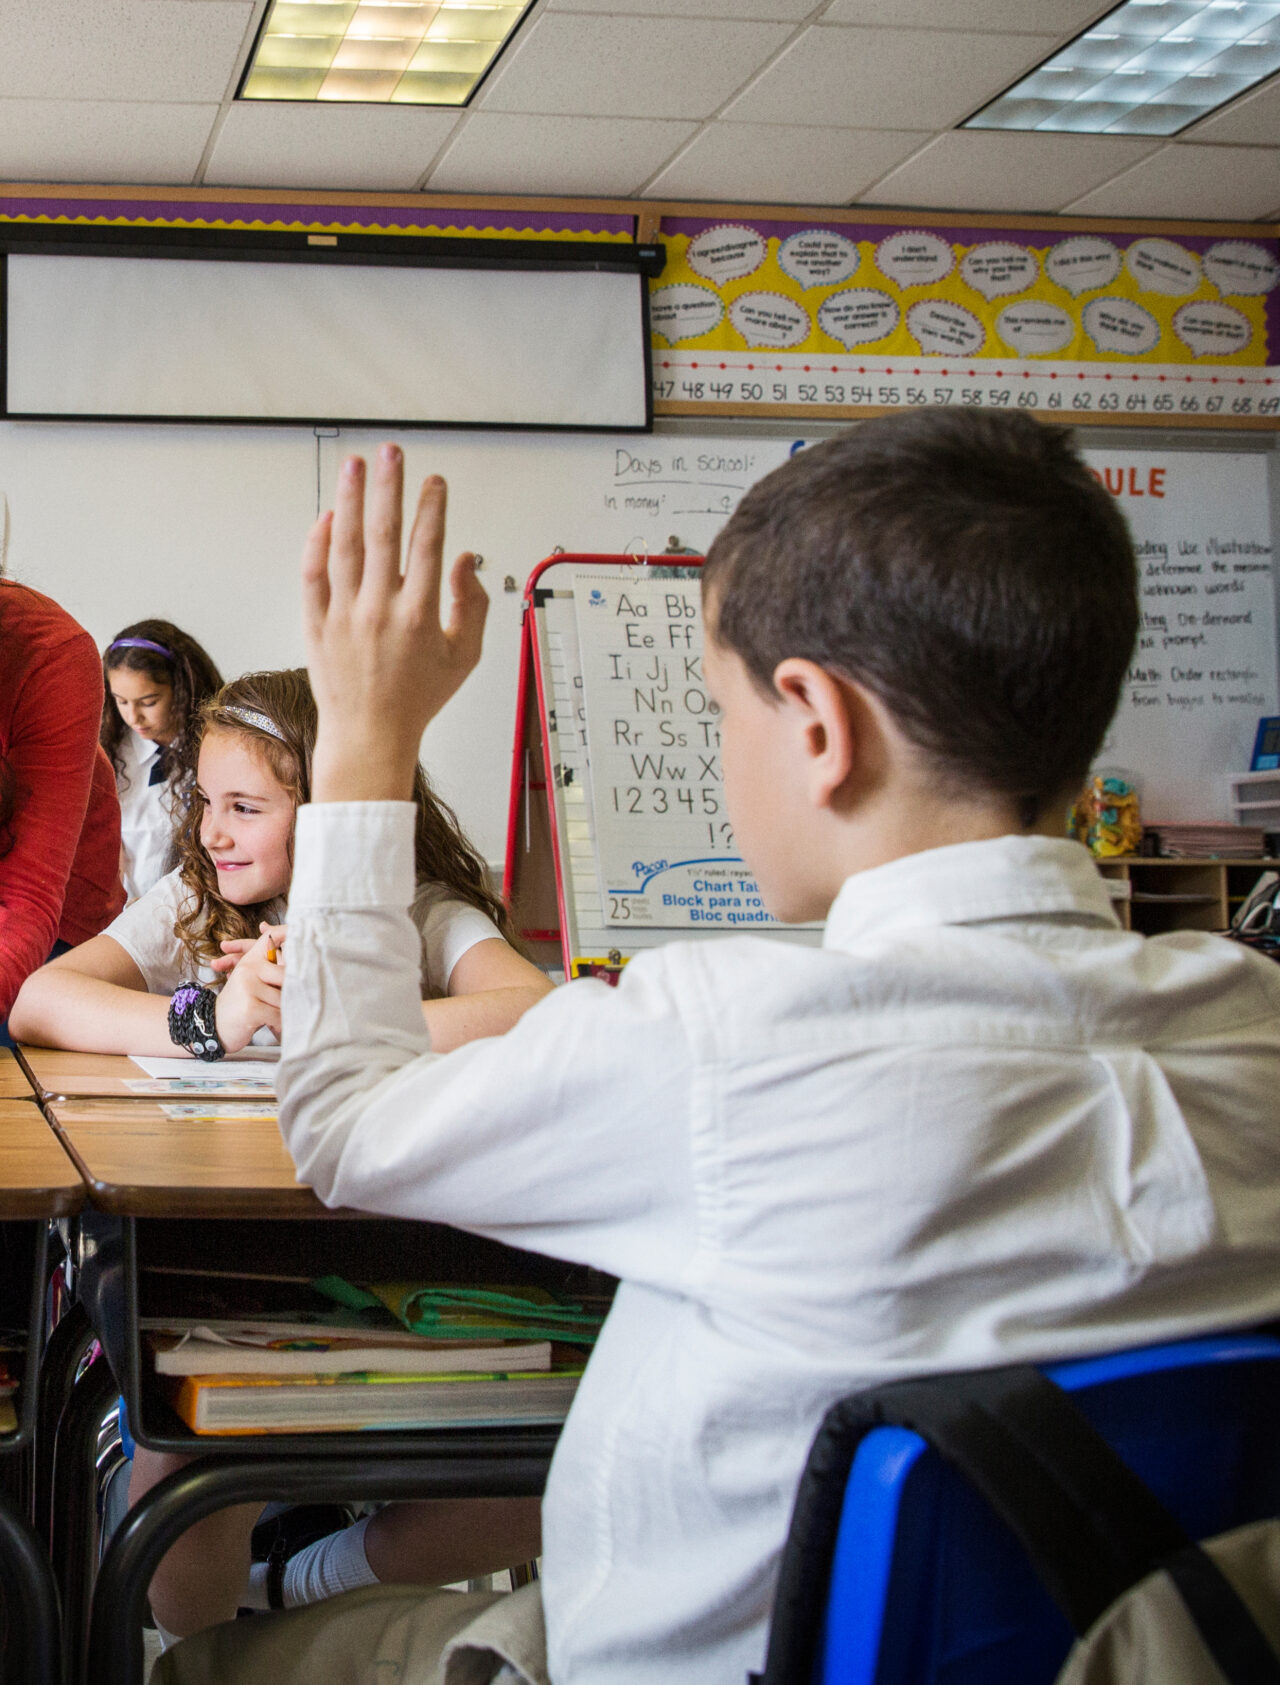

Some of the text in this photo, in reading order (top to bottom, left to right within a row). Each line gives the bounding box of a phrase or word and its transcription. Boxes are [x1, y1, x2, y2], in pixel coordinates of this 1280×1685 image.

[653, 381, 675, 401] 47
[682, 381, 705, 400] 48
[710, 381, 734, 400] 49
[741, 382, 763, 401] 50
[772, 384, 788, 402] 51
[798, 385, 818, 402] 52
[825, 386, 846, 402] 53
[851, 386, 873, 404] 54
[879, 387, 900, 404] 55
[906, 388, 928, 405] 56
[934, 389, 954, 405] 57
[962, 389, 983, 406] 58
[989, 389, 1011, 407] 59
[1018, 391, 1039, 408] 60
[1048, 392, 1063, 409] 61
[1072, 393, 1092, 410] 62
[1099, 394, 1120, 411] 63
[1126, 394, 1147, 411] 64
[1153, 395, 1174, 411] 65
[1180, 396, 1199, 412] 66
[1205, 396, 1224, 413] 67
[1232, 397, 1253, 414] 68
[614, 449, 663, 478] Days
[672, 456, 688, 472] in
[616, 594, 648, 618] Aa
[665, 593, 697, 619] Bb
[626, 623, 694, 650] Ee Ff
[609, 654, 632, 681] Ii
[646, 656, 669, 692] Jj
[634, 688, 721, 716] Nn Oo
[614, 720, 643, 747] Rr
[659, 720, 688, 748] Ss
[630, 753, 686, 781] Ww
[612, 786, 719, 815] 1 2 3 4 5
[631, 858, 669, 878] Pacon
[692, 879, 734, 893] Chart
[609, 897, 632, 920] 25
[662, 894, 704, 907] Block
[708, 896, 743, 909] para
[689, 908, 723, 922] Bloc
